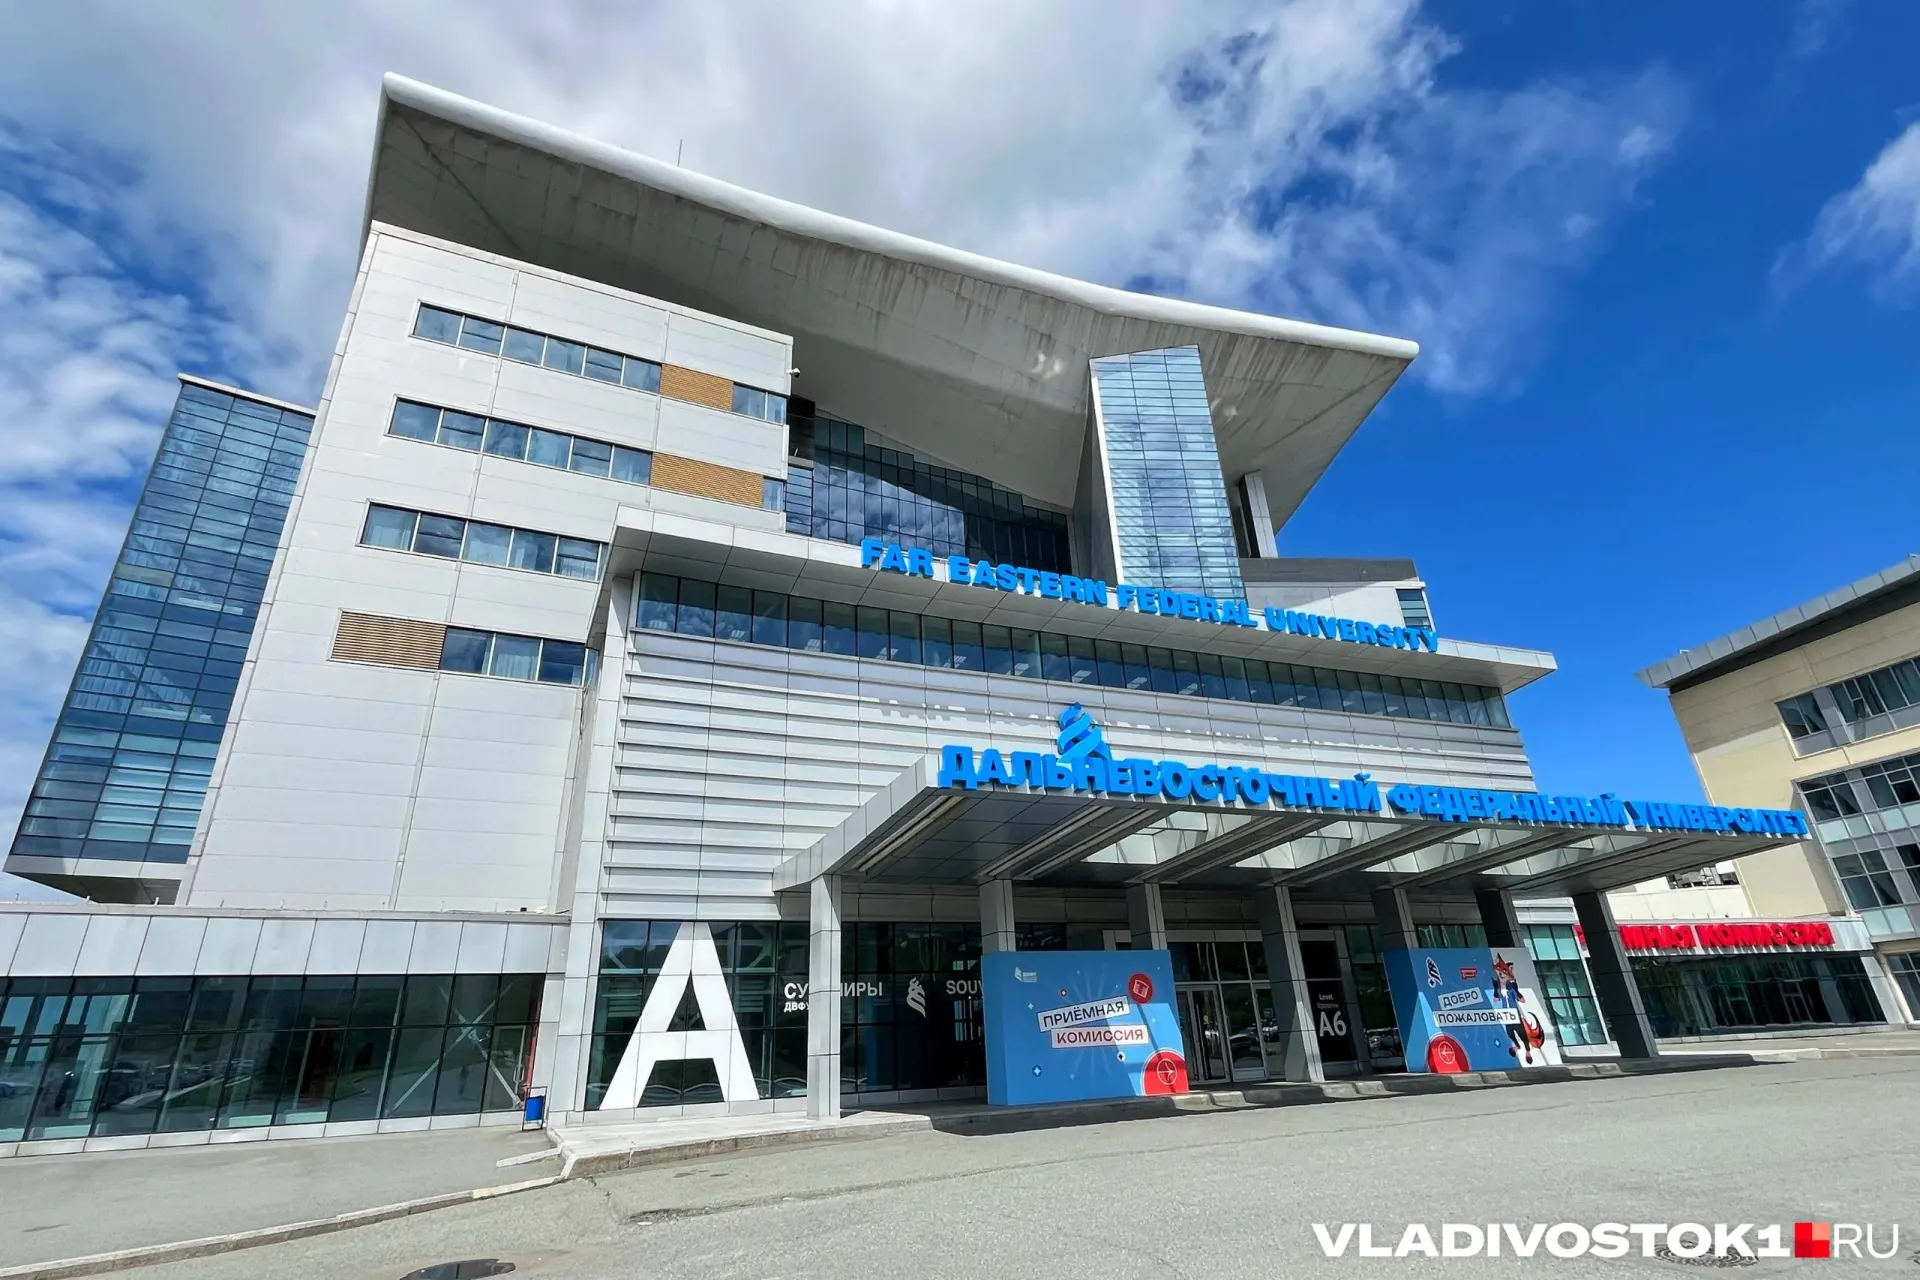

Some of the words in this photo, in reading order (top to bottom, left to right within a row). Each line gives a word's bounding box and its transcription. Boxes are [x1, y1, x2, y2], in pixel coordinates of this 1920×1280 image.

[861, 538, 933, 577] FAR
[949, 556, 1107, 606] EASTERN
[1117, 584, 1258, 627] FEDERAL
[1265, 606, 1438, 653] UNIVERSITY
[938, 744, 1382, 813] ДАЛЬНЕВОСТОЧНЫЙ
[1387, 784, 1629, 824] ФЕДЕРАЛЬНЫЙ
[1622, 800, 1810, 836] УНИВЕРСИТЕТ
[1695, 922, 1836, 947] КОМИССИЯ
[784, 982, 883, 999] СУИРЫ
[1442, 990, 1479, 1007] ДОБРО
[1043, 1000, 1125, 1028] ПРИЁМНАЯ
[1319, 1010, 1347, 1037] A6
[1438, 1011, 1517, 1024] ПОЖАЛОВАТЬ
[1056, 1028, 1143, 1045] КОМИССИЯ
